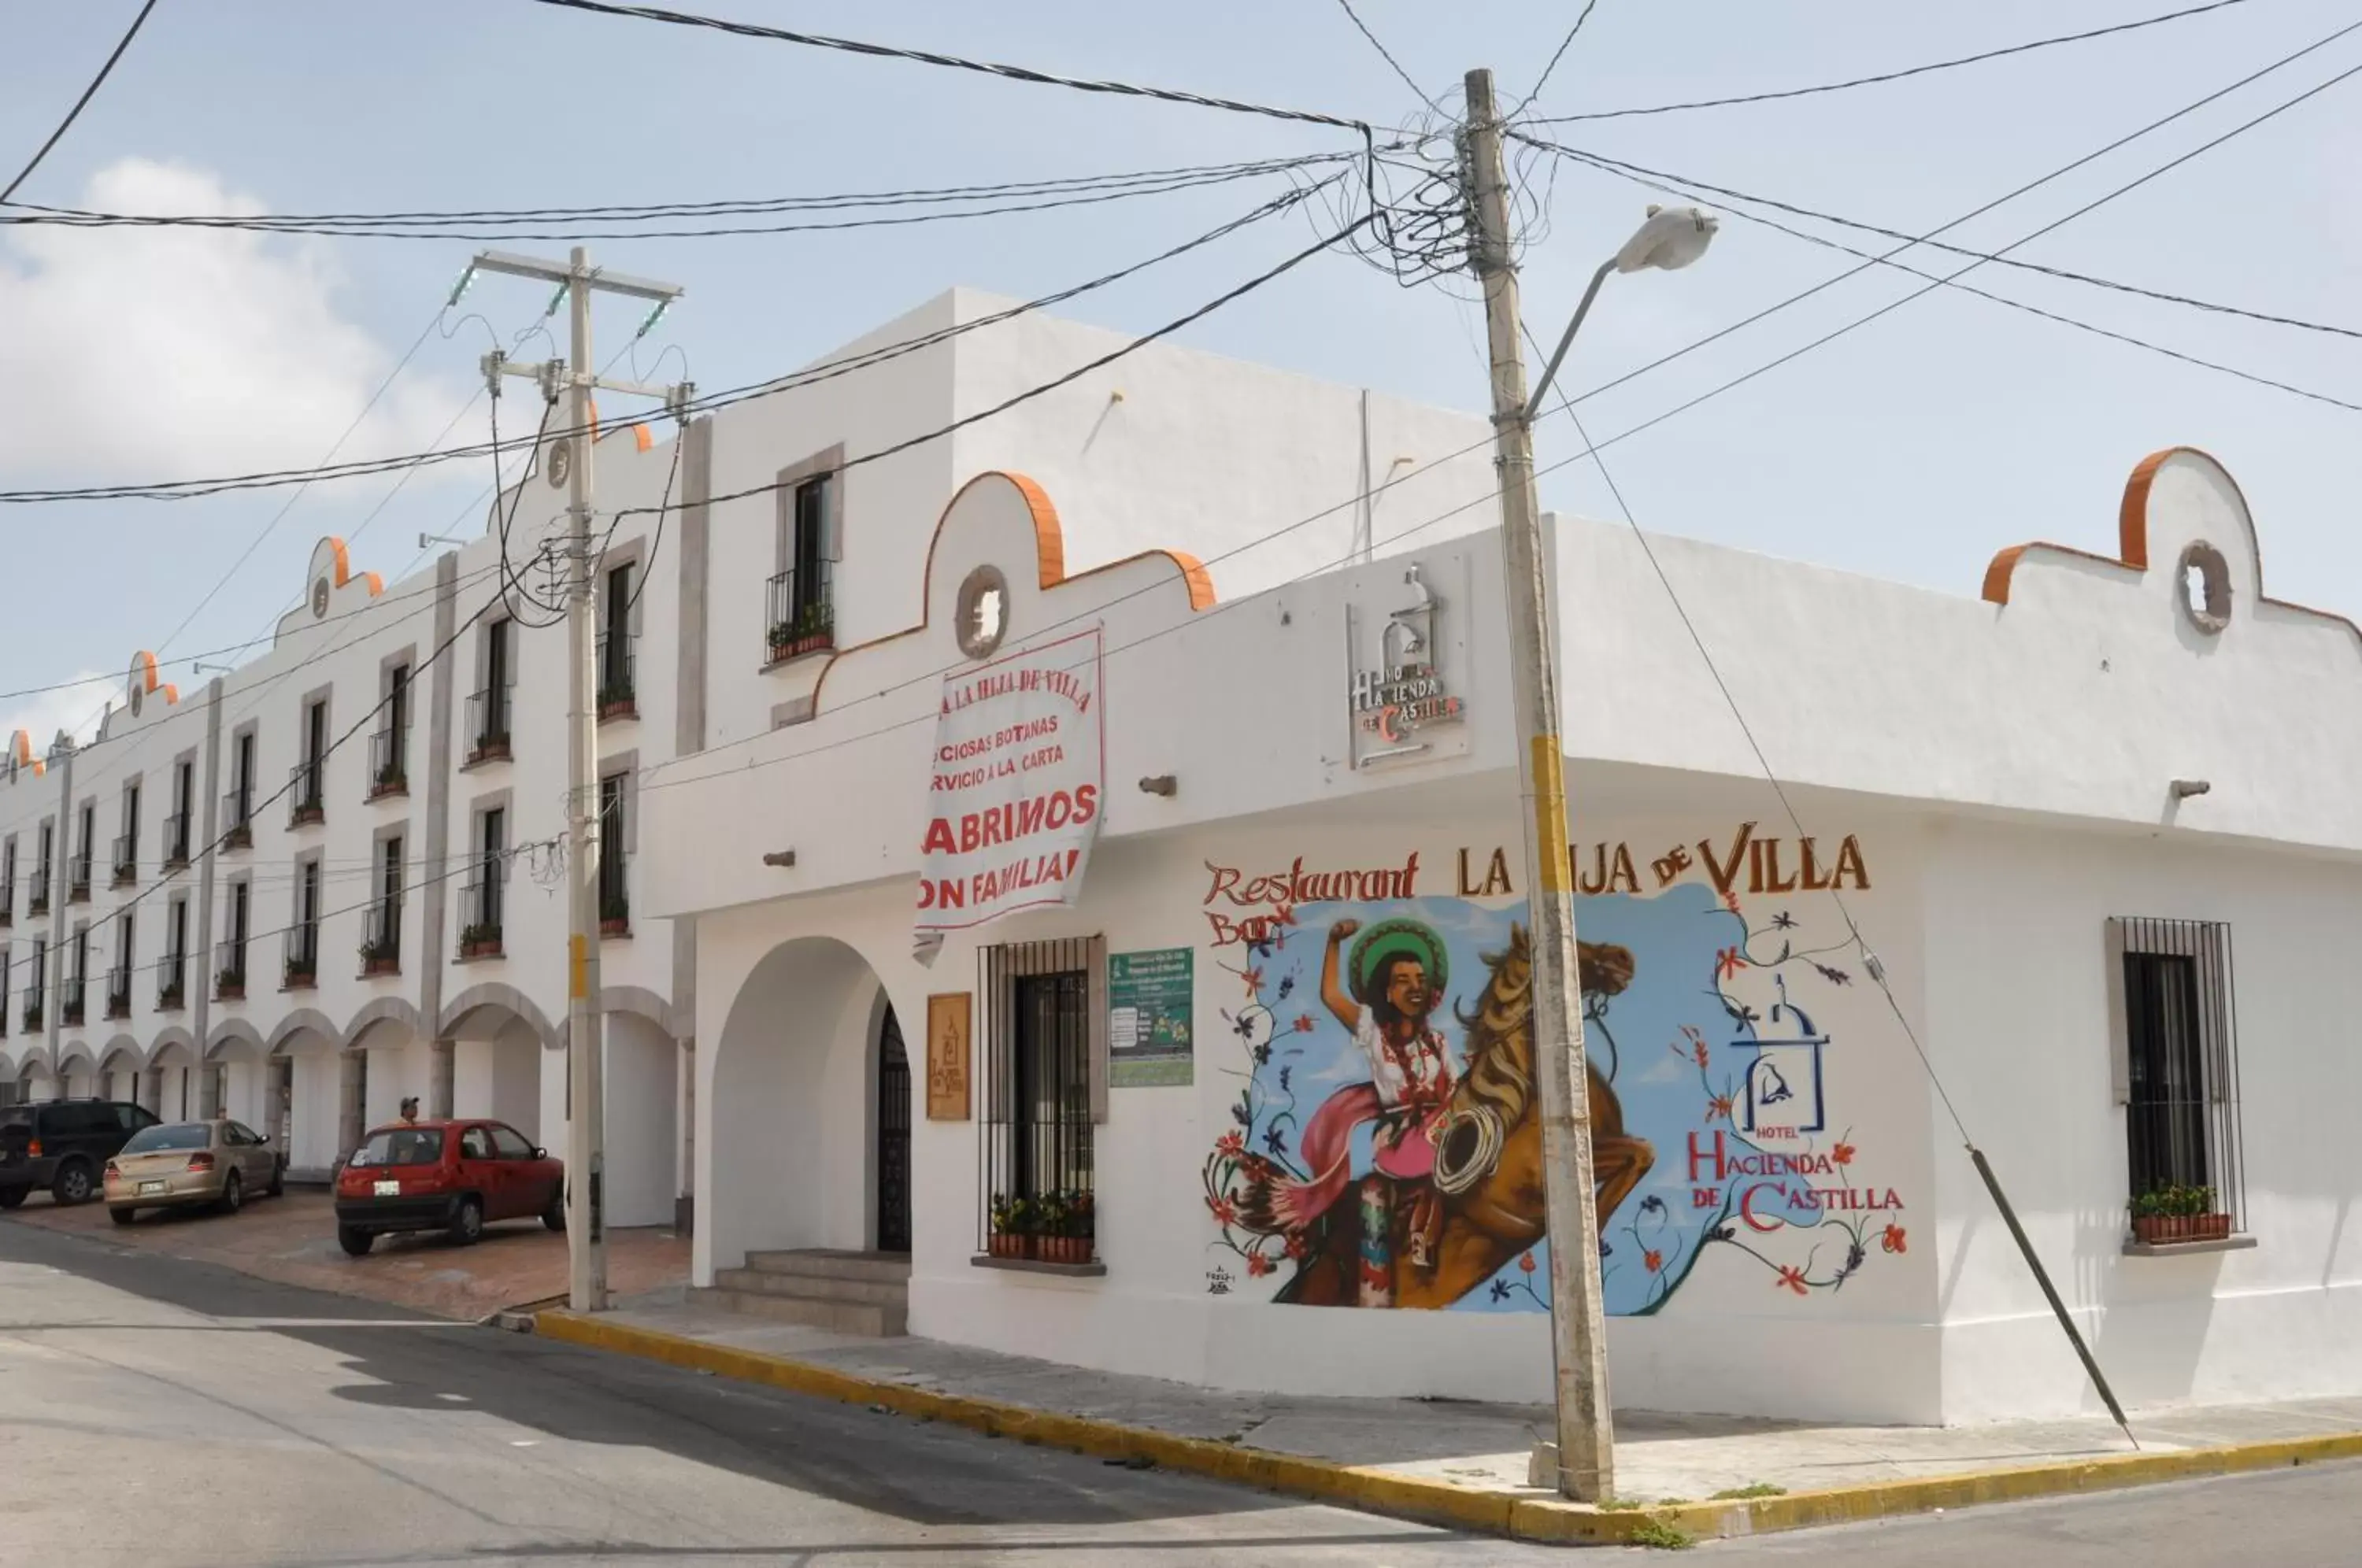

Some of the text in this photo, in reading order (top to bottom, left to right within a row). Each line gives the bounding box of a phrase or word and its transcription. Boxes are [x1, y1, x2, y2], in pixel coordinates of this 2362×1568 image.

[955, 686, 973, 710] LA
[977, 671, 1014, 701] HIJA
[1020, 669, 1040, 692] DE
[1046, 669, 1092, 714] VILLA
[933, 715, 1057, 768] CIOSAS BOTANAS
[988, 764, 994, 781] A
[998, 758, 1016, 777] LA
[1022, 745, 1064, 771] CARTA
[1204, 821, 1871, 905] Restaurant LA IJA DE VILLA
[1688, 1129, 1833, 1182] HACIENDA
[1756, 1126, 1799, 1139] HOTEL
[1693, 1181, 1904, 1232] DE CASTILLA
